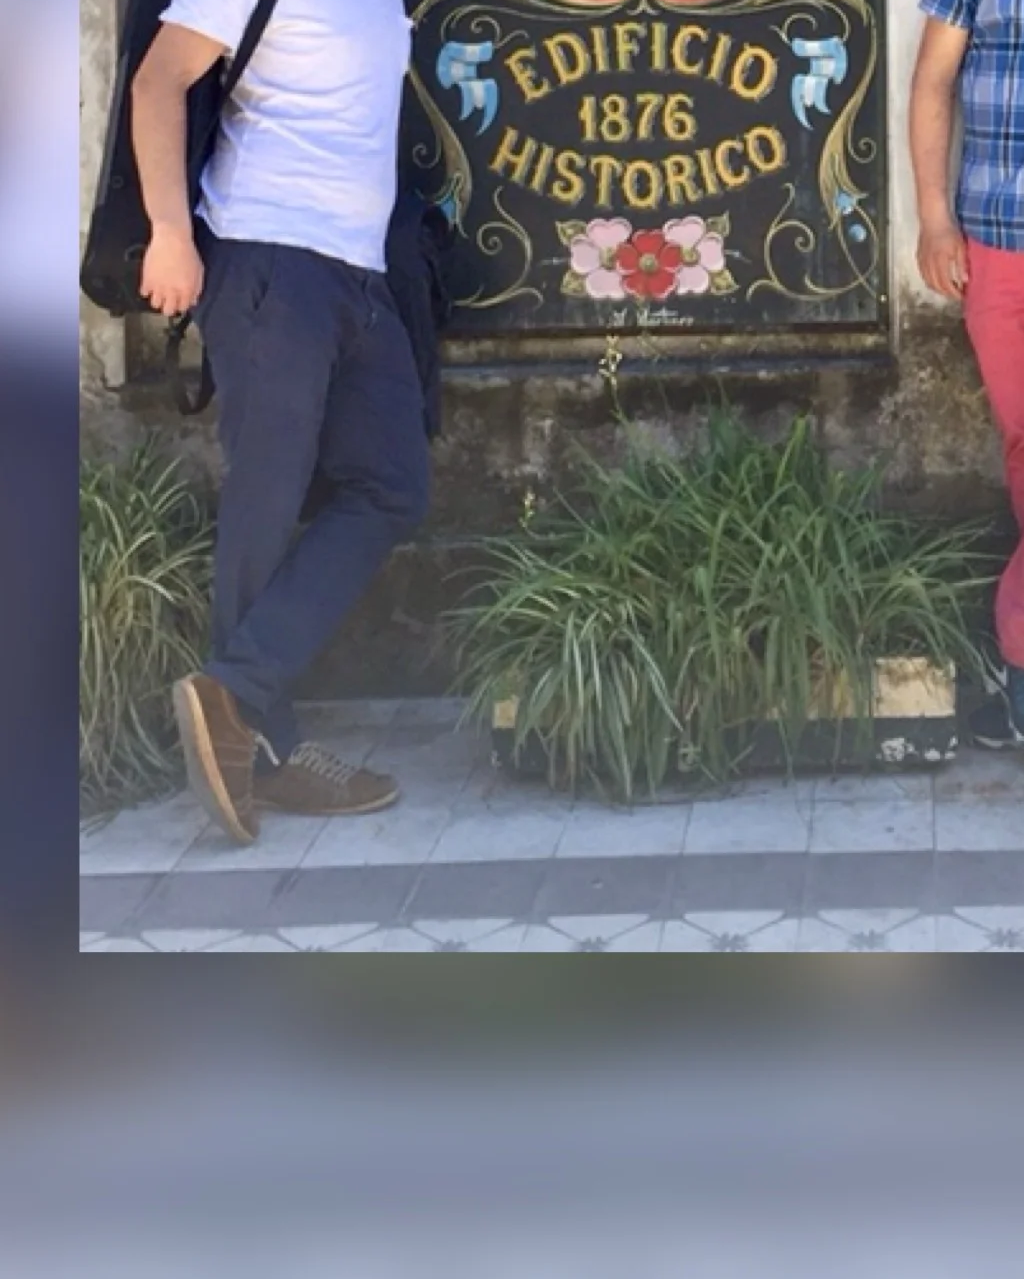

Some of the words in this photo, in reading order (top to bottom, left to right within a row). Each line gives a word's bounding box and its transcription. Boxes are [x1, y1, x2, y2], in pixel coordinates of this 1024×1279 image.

[504, 22, 779, 103] EDIFICIO
[578, 93, 697, 142] 1876
[489, 125, 786, 209] HISTORICO
